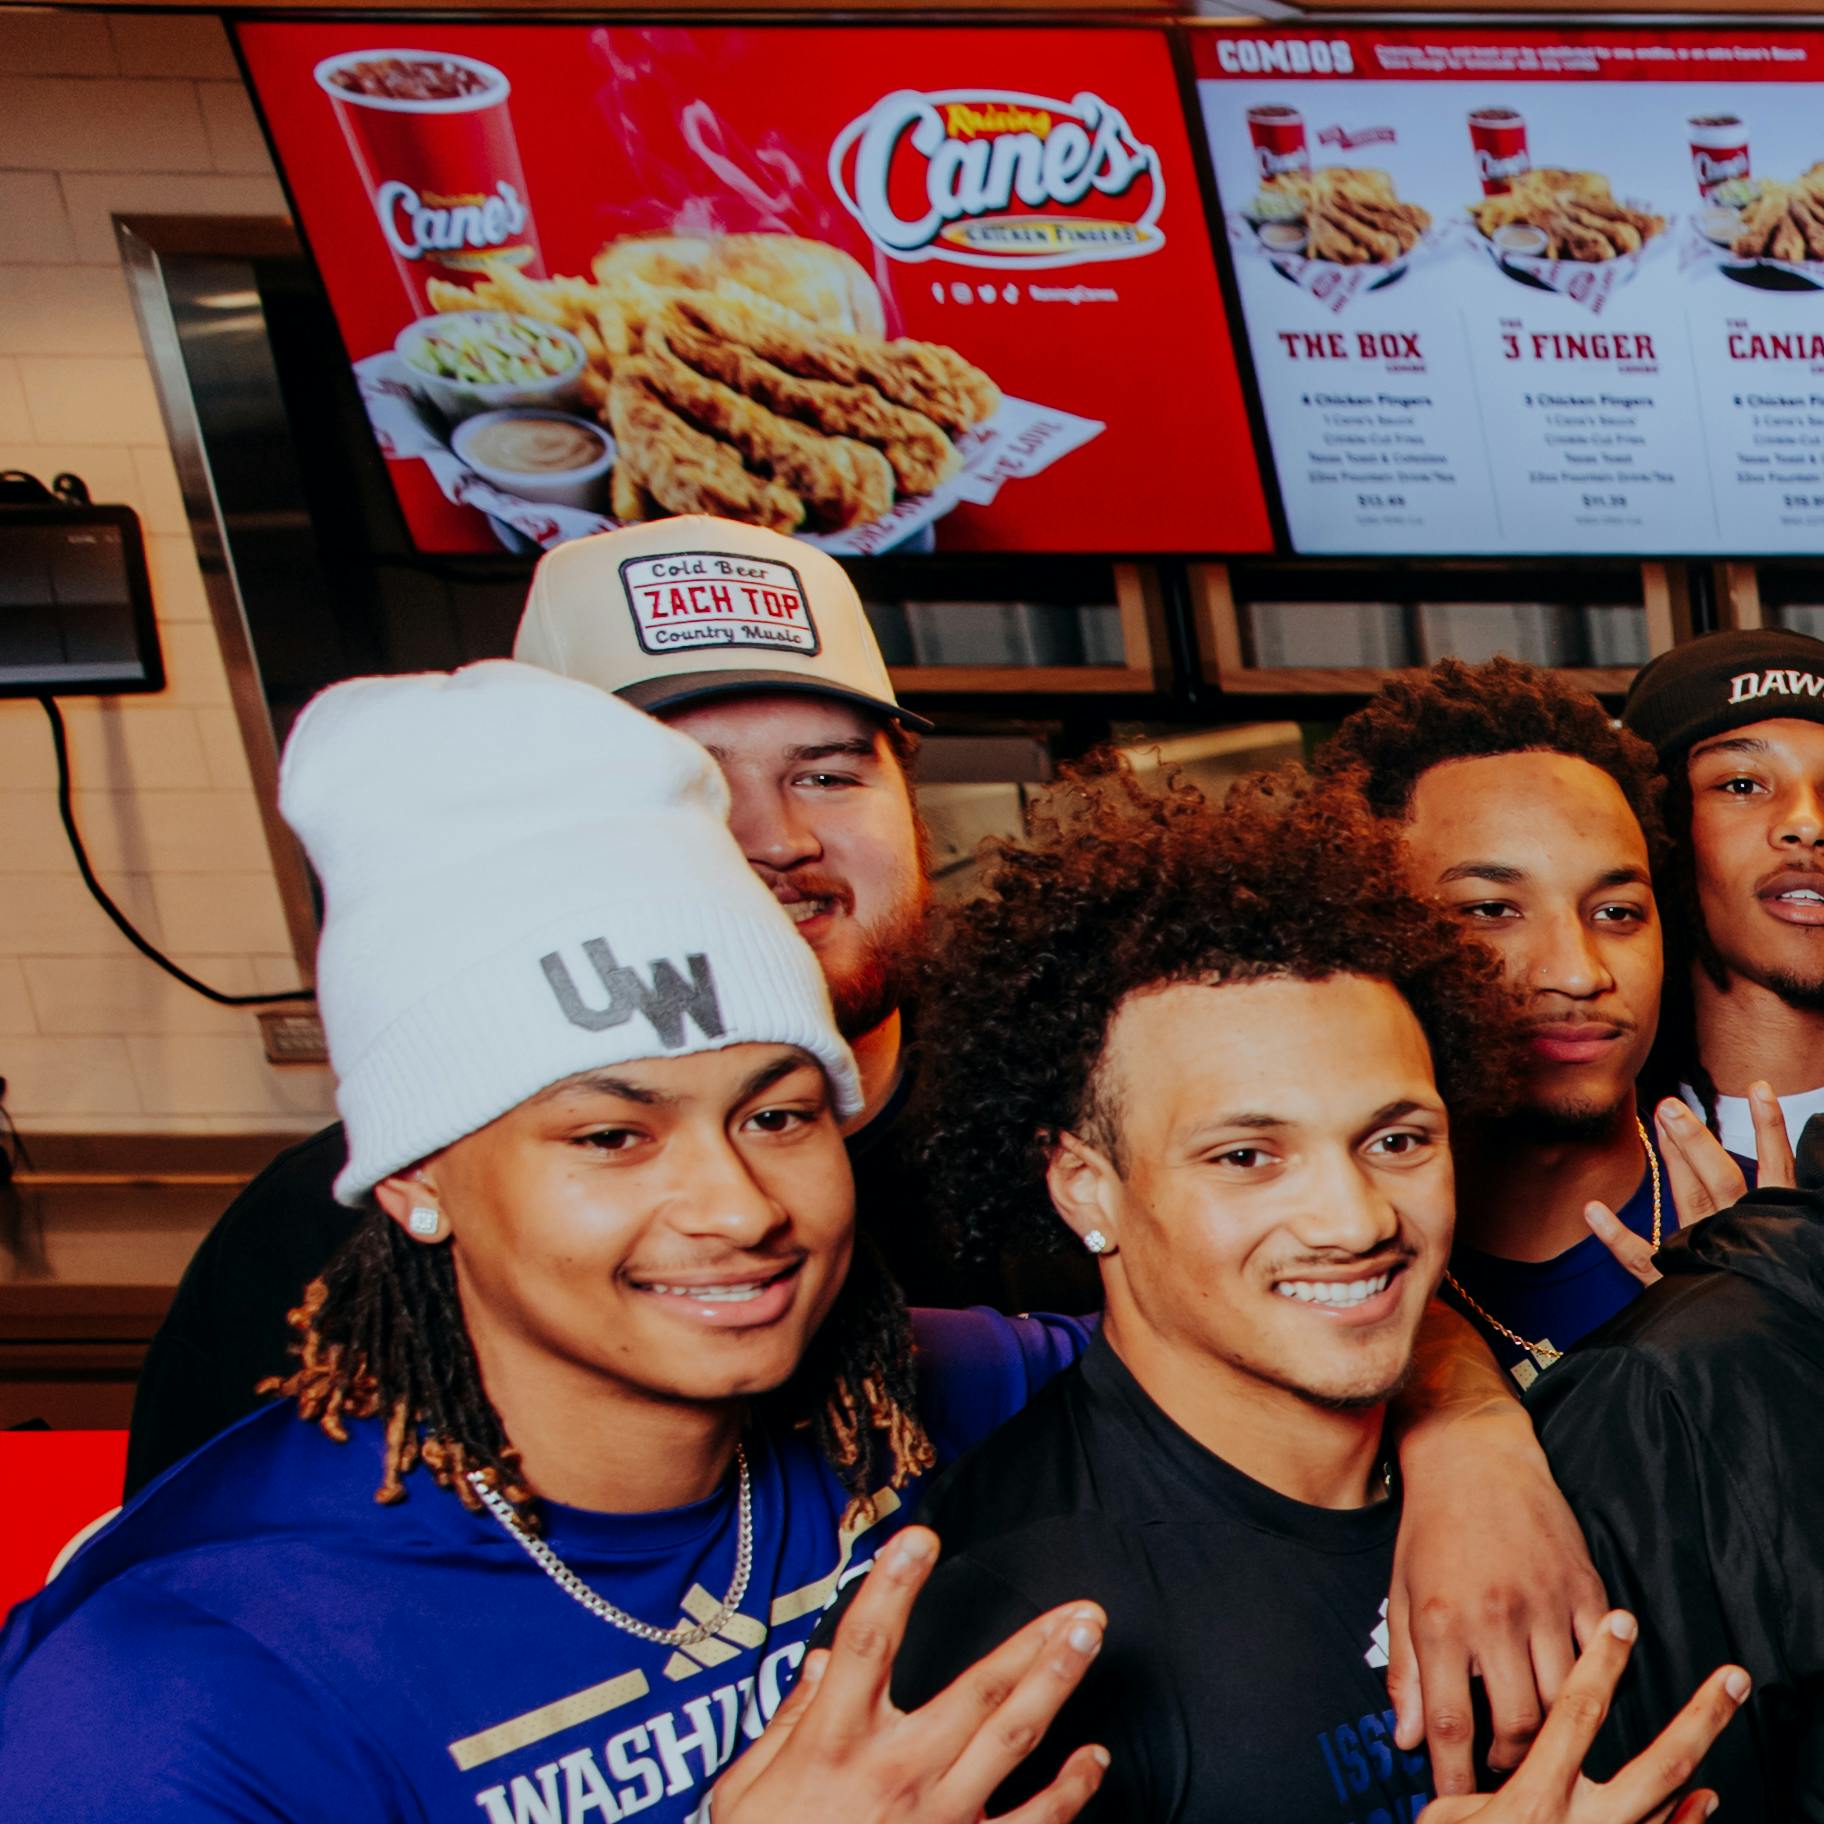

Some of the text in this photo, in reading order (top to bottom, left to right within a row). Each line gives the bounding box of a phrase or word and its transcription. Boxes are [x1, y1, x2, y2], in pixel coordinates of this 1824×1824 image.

[1217, 40, 1354, 73] COMBOS
[855, 90, 1152, 250] Cane's
[1278, 332, 1423, 360] THE BOX
[1502, 334, 1656, 361] 3 FINGER
[652, 560, 769, 580] Cold Beer
[643, 585, 801, 620] ZACH TOP
[656, 624, 804, 646] Country Music
[540, 935, 728, 1051] UW
